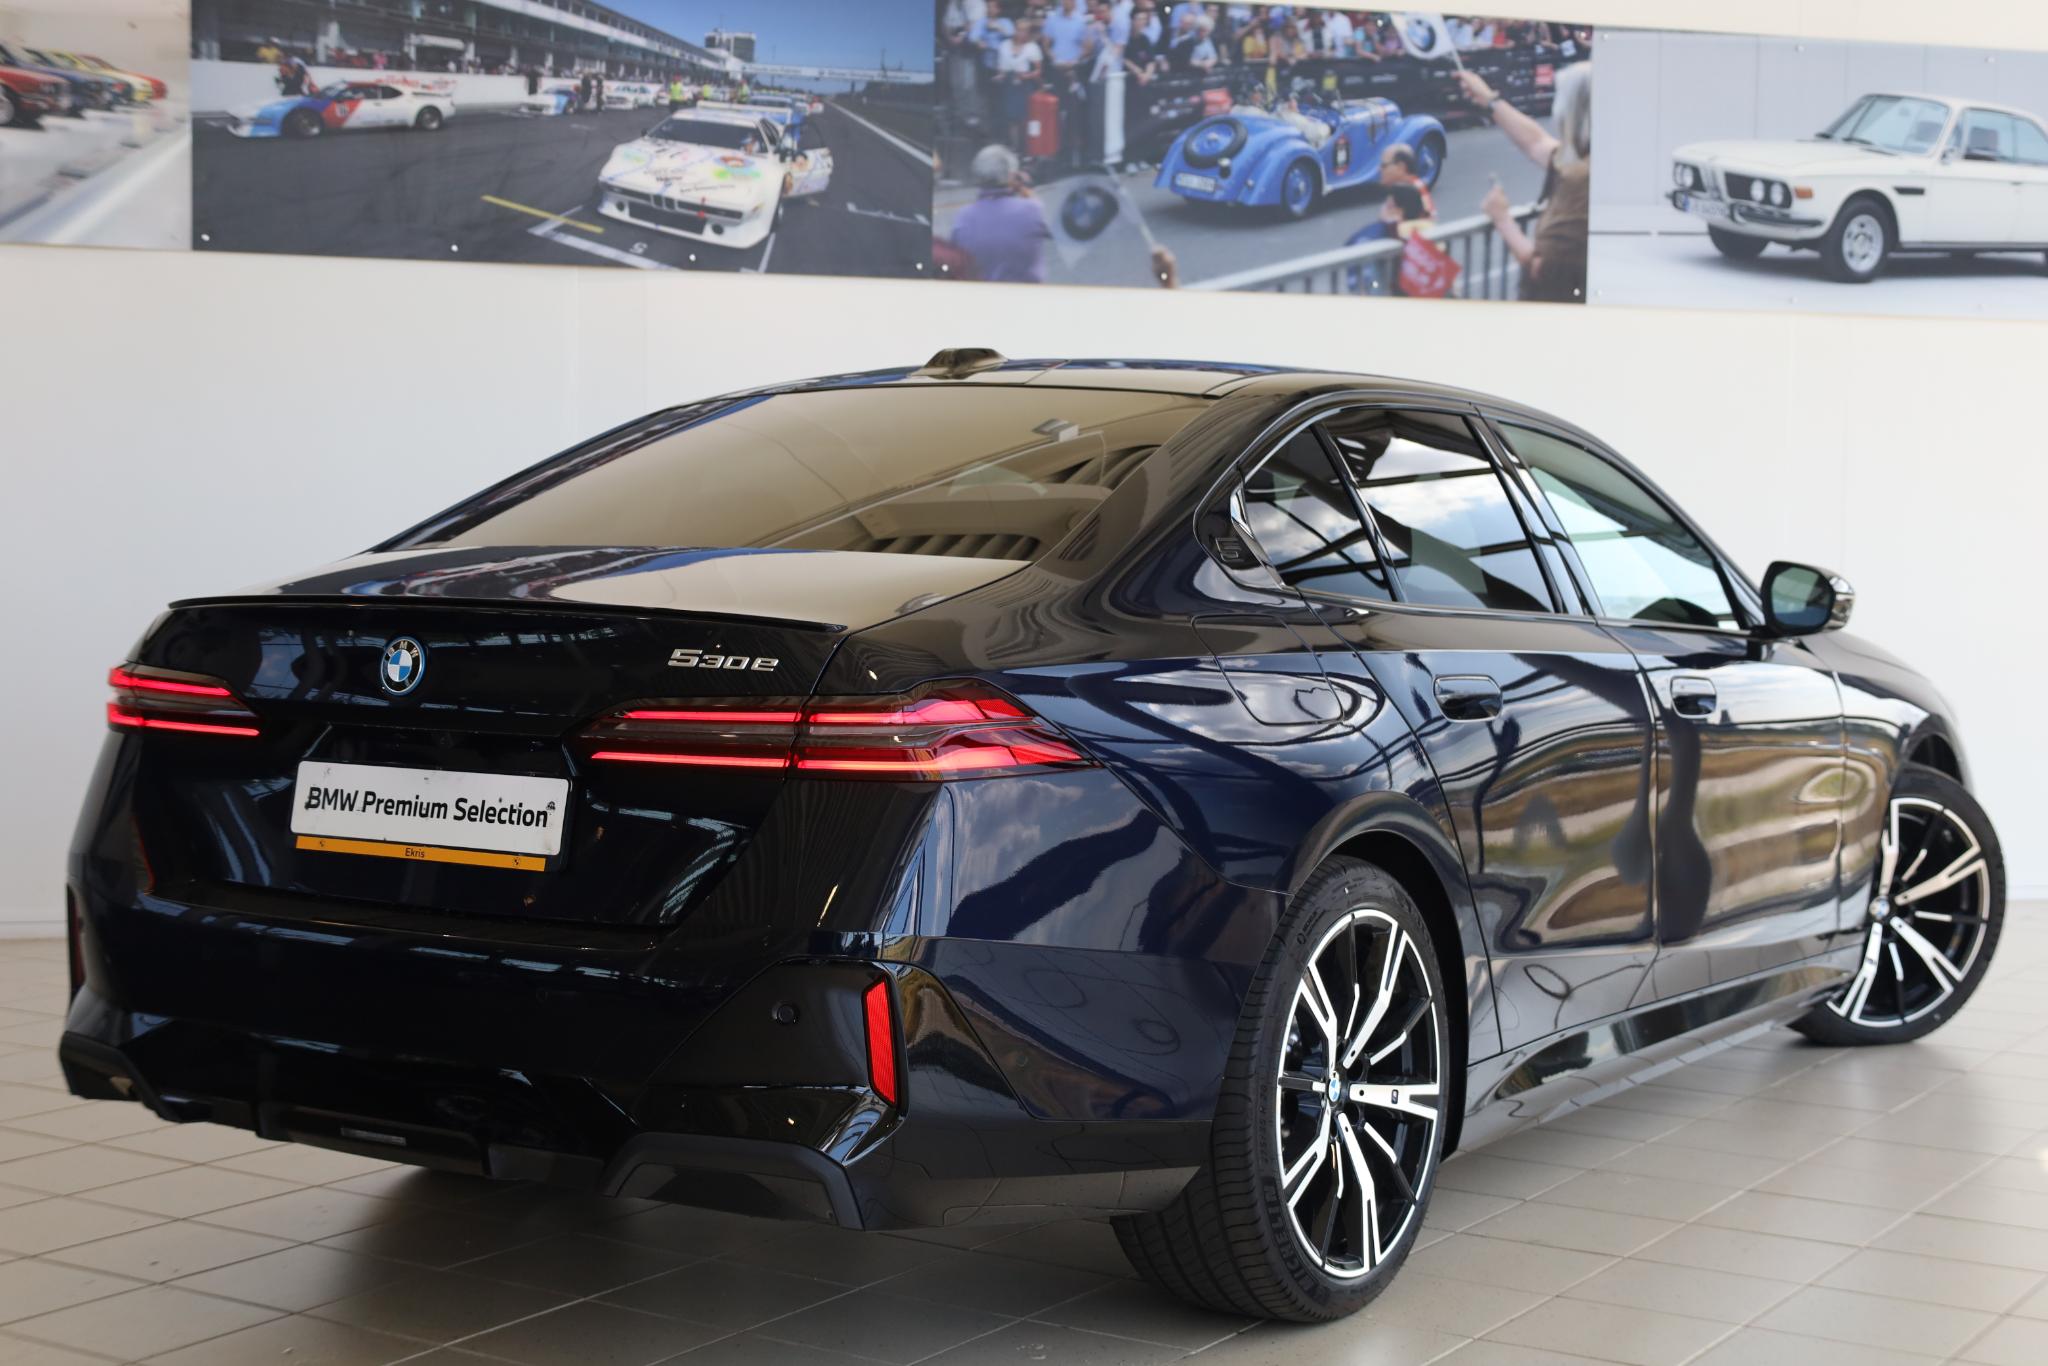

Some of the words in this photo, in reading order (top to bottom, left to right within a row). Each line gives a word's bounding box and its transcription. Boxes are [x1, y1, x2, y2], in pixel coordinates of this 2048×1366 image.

[667, 648, 779, 672] 530e
[308, 786, 358, 813] BMW
[362, 790, 448, 820] Premium
[405, 847, 425, 859] Ekris
[1263, 1185, 1316, 1293] MICHELIN
